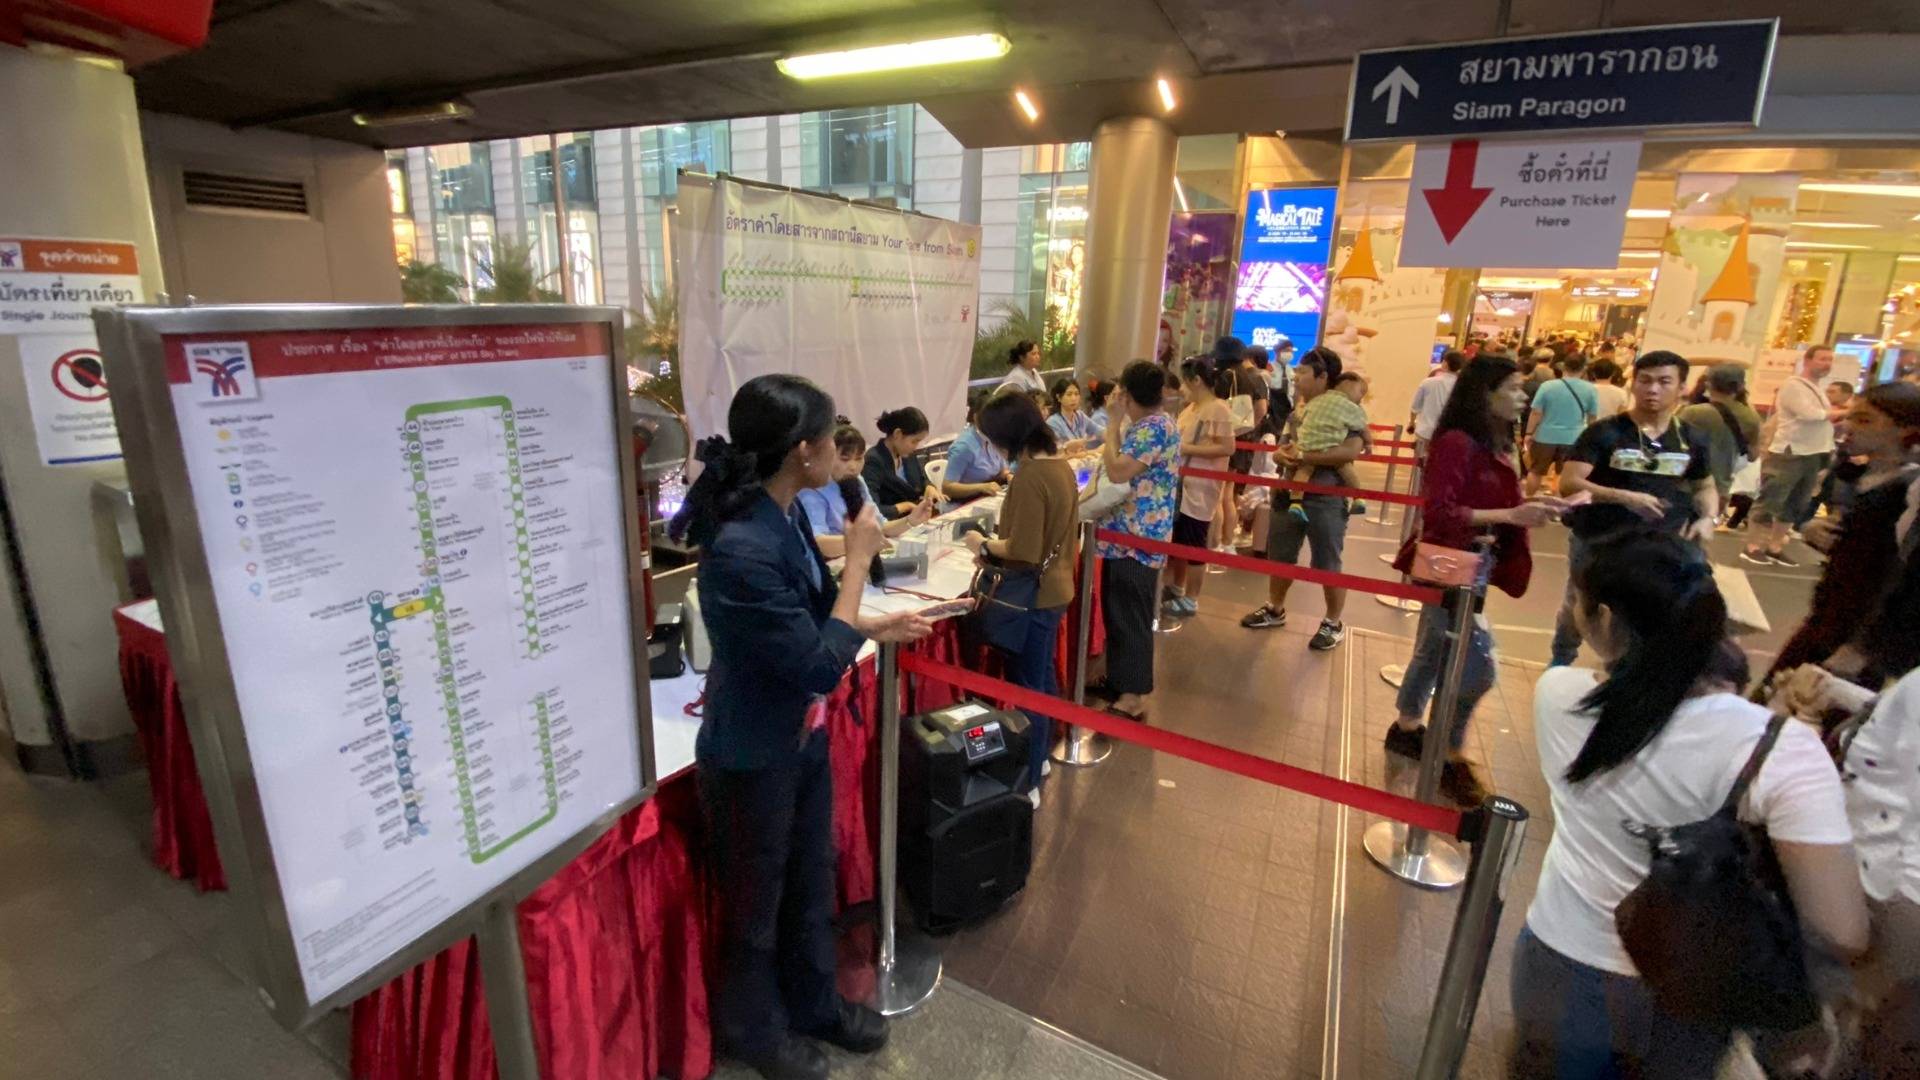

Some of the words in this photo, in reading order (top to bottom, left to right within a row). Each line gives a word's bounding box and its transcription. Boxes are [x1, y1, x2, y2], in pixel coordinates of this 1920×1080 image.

[1459, 44, 1719, 85] สยามพารากอน
[1452, 101, 1512, 121] Siam
[1519, 96, 1627, 119] Paragon
[1500, 195, 1567, 207] Purchase
[1572, 194, 1617, 206] Ticket
[1536, 216, 1571, 227] Here
[882, 234, 904, 249] Your
[923, 241, 944, 254] from
[1, 310, 45, 322] Single
